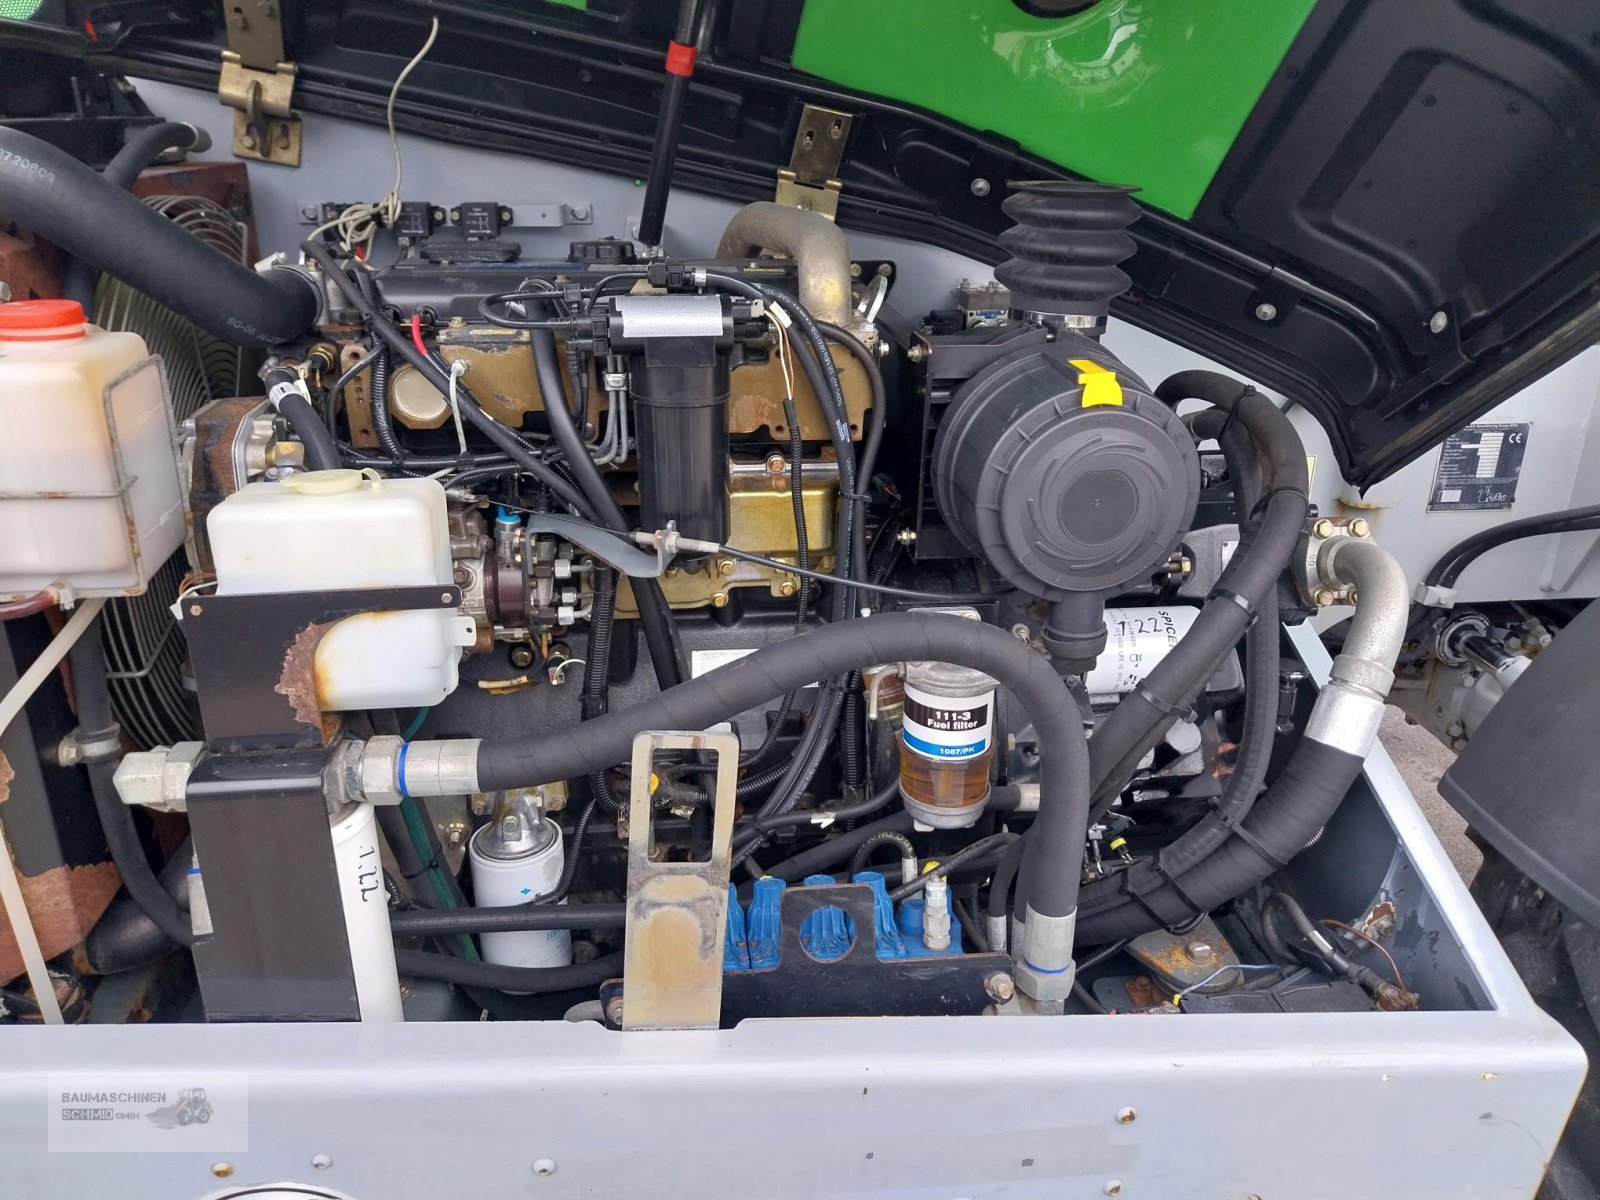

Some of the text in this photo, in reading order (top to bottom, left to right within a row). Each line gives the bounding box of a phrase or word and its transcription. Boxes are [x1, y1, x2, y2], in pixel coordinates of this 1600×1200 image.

[1509, 433, 1522, 444] CE
[935, 711, 971, 721] 111-3
[927, 718, 978, 730] Fuel filter
[939, 746, 975, 755] 1087/PK
